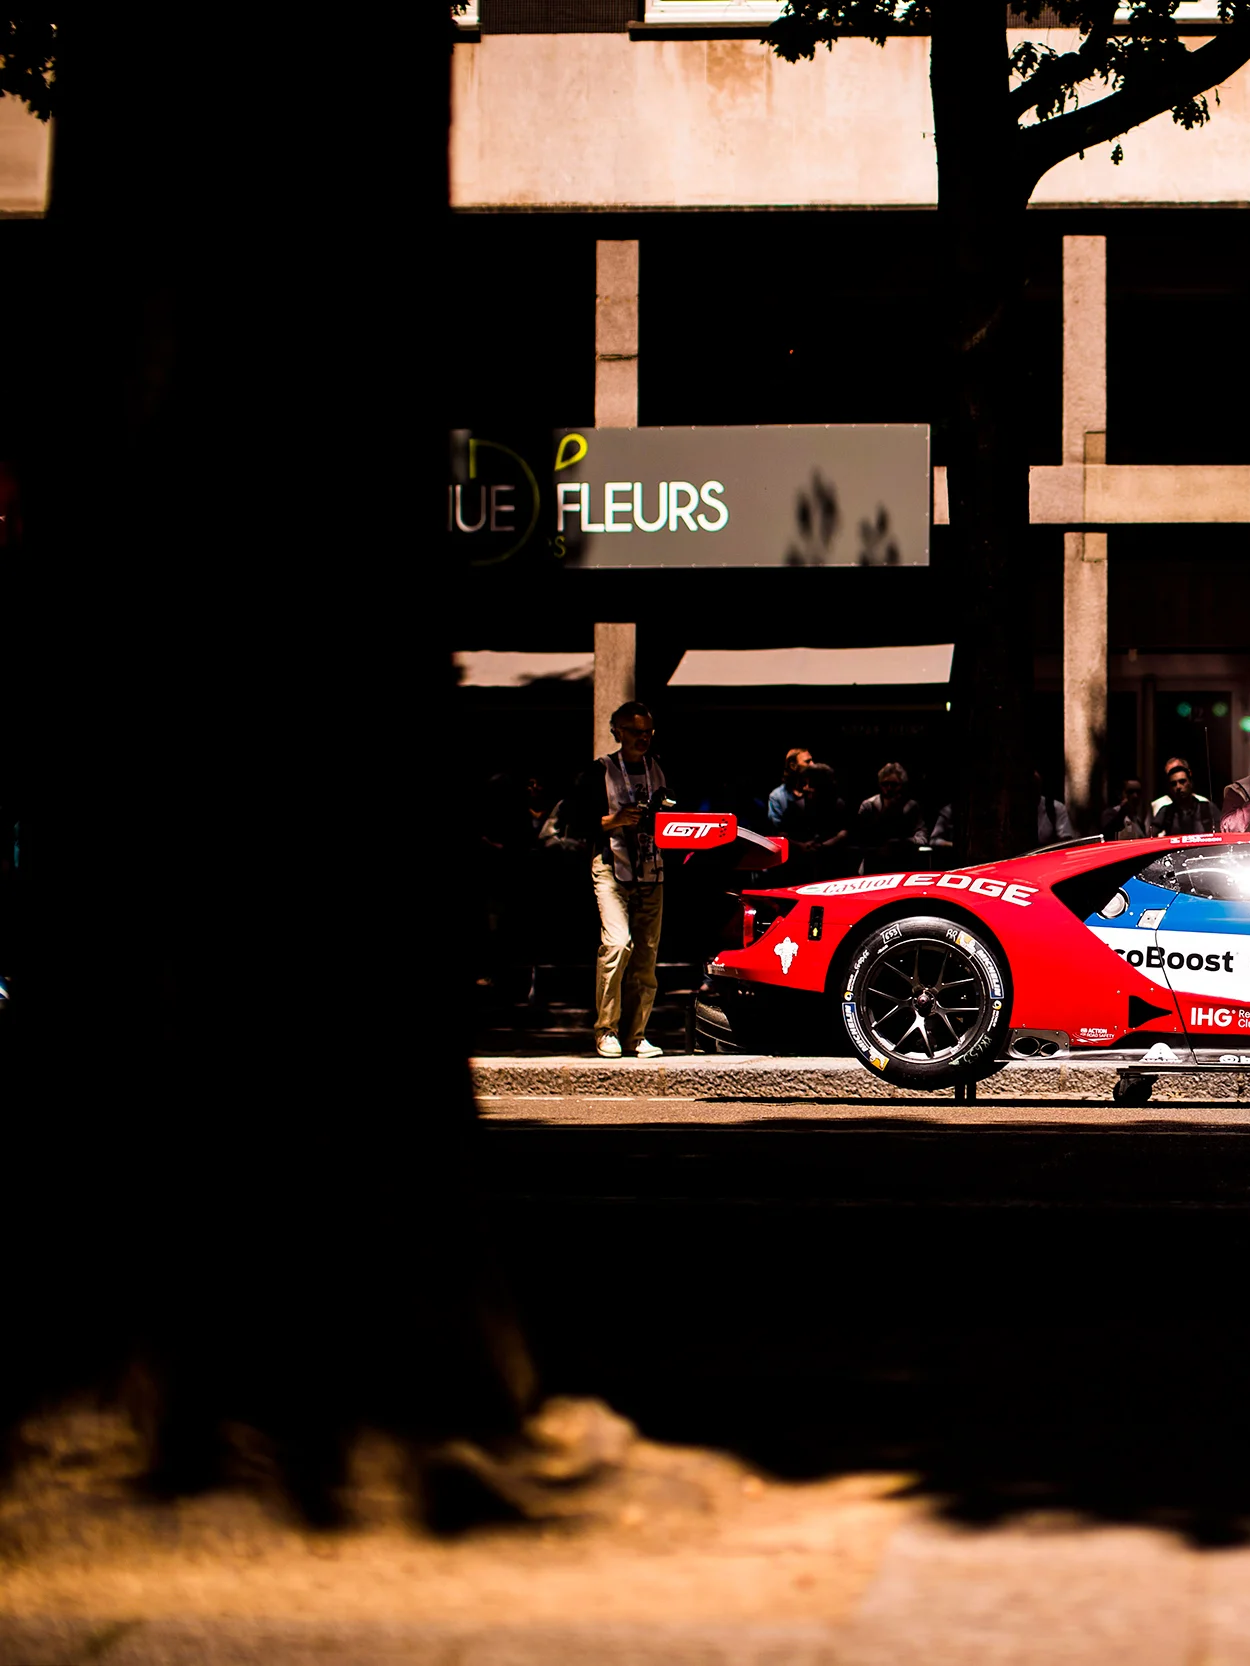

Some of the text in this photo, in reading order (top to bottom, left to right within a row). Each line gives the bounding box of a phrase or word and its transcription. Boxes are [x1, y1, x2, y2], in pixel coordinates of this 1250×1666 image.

[557, 481, 728, 533] FLEURS
[662, 822, 728, 839] GT
[823, 874, 1040, 906] Castrol EDGE
[976, 949, 1002, 998] MICHELIN
[844, 1004, 869, 1053] MICHELIN
[1191, 1007, 1233, 1027] IHG
